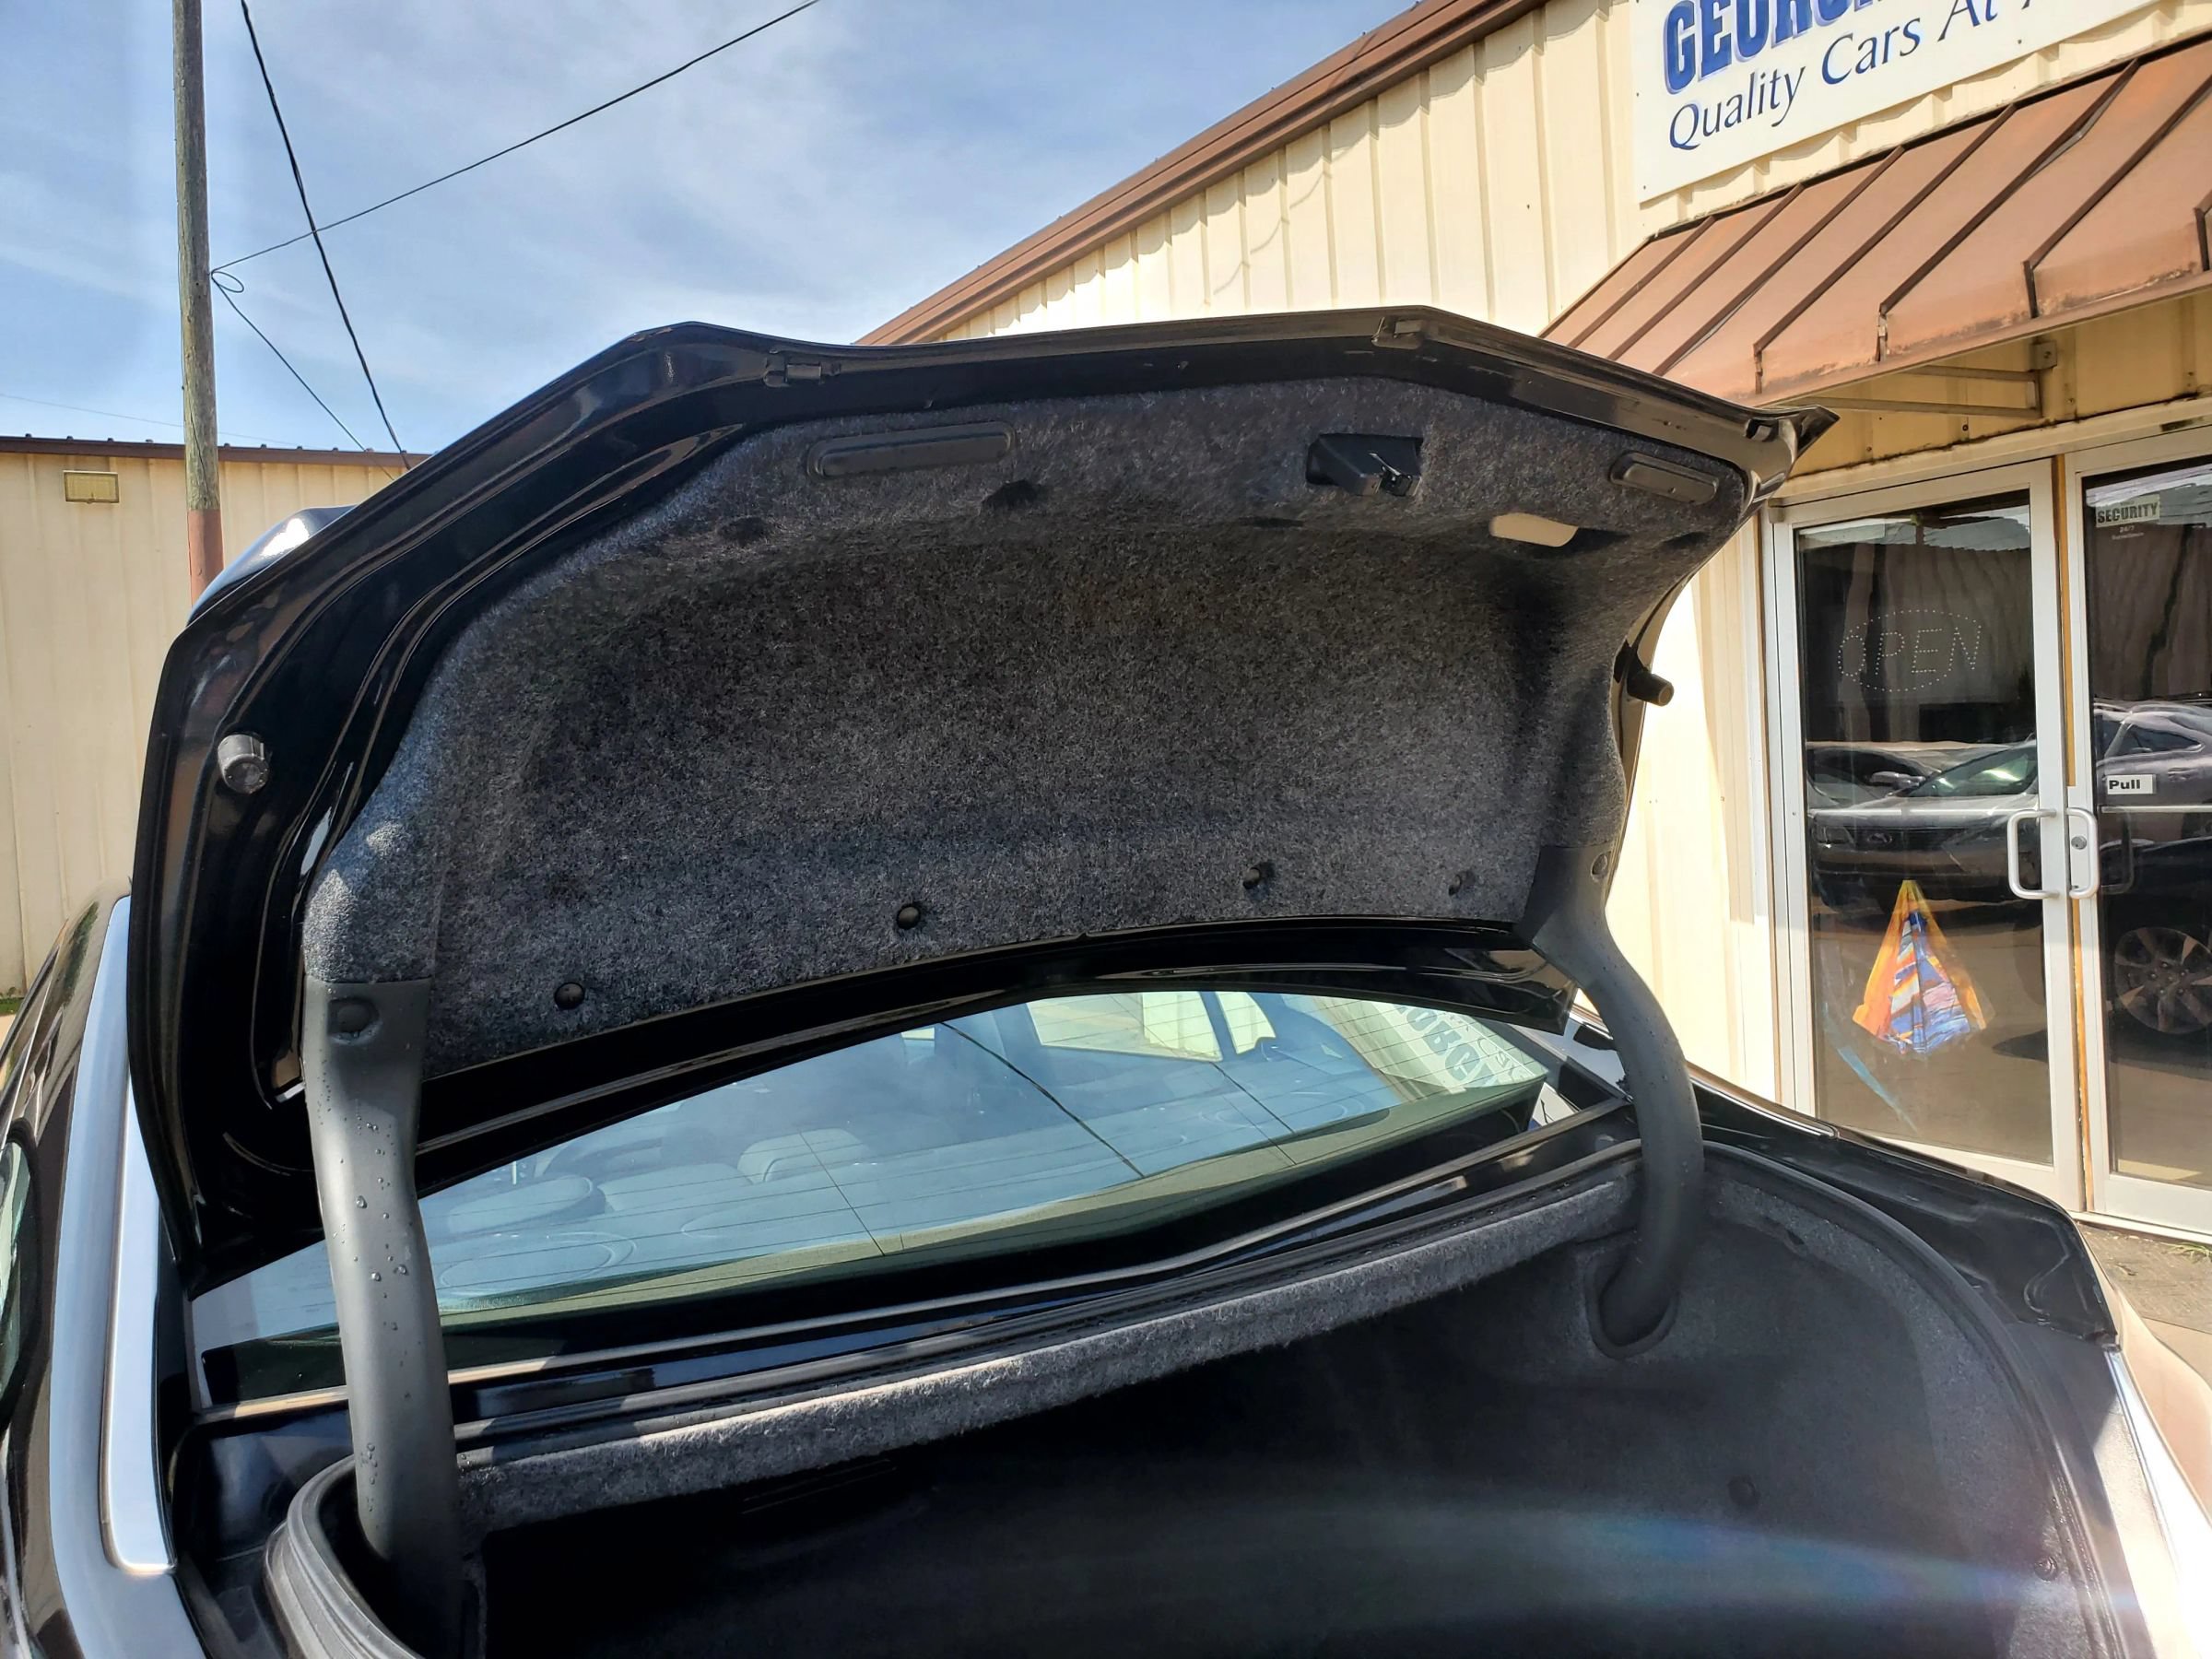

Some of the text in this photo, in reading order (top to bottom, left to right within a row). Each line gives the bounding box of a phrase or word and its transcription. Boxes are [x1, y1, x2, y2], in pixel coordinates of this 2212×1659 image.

[1669, 65, 1806, 150] Quality
[1821, 18, 1921, 85] Cars
[2098, 503, 2158, 524] SECURITY
[1838, 625, 1982, 677] OPEN
[2109, 779, 2141, 790] Pull
